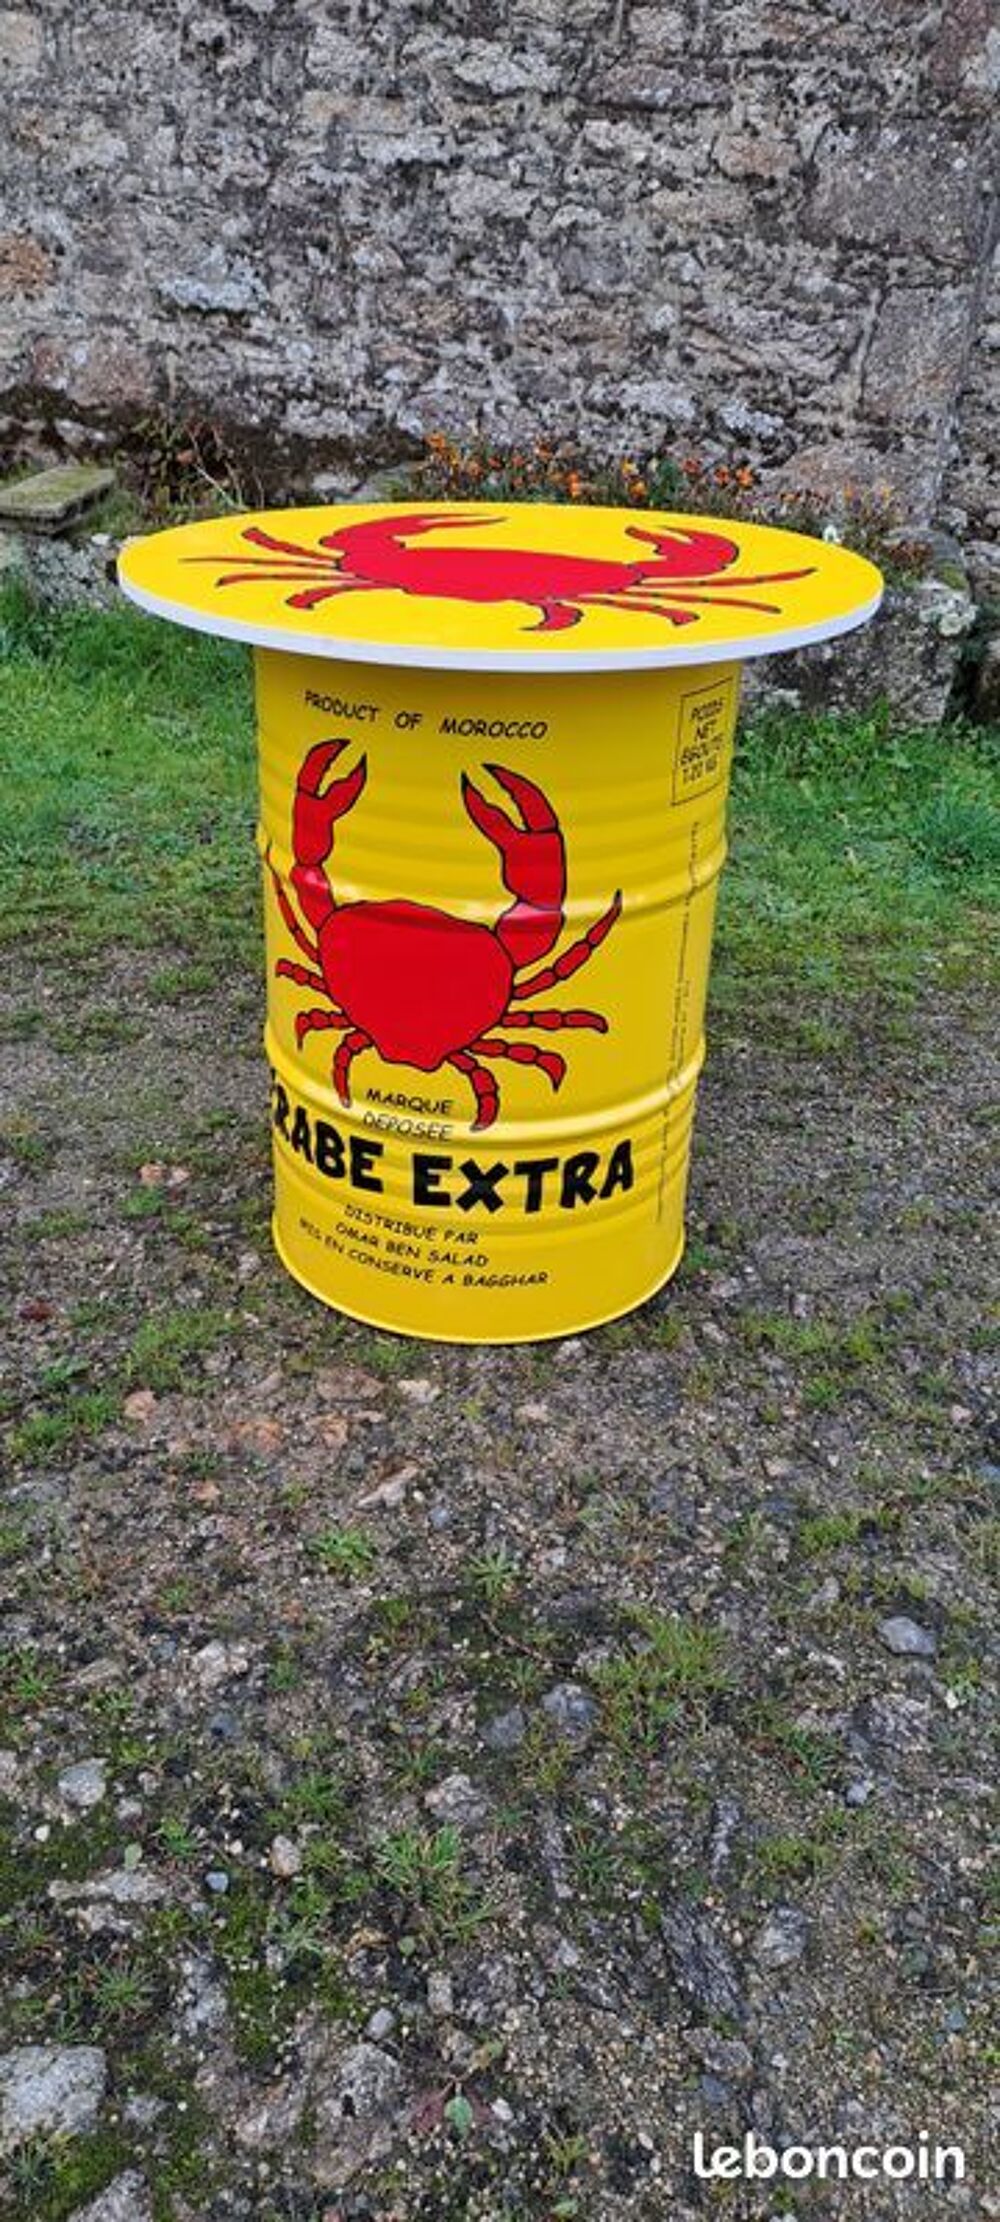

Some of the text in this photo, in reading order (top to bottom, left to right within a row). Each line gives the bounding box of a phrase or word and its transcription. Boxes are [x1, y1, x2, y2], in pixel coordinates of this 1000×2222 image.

[304, 690, 548, 740] PRODUCT OF MOROCCO
[366, 1088, 453, 1115] MARQUE
[271, 1067, 633, 1213] RABE EXTRA
[363, 1111, 453, 1142] DEPOSEE
[335, 1221, 489, 1268] OMAR BEN SALAD
[344, 1204, 479, 1245] DISTRIBUE PAR
[325, 1235, 345, 1254] EN
[347, 1249, 434, 1284] CONSERVE
[441, 1273, 455, 1285] A
